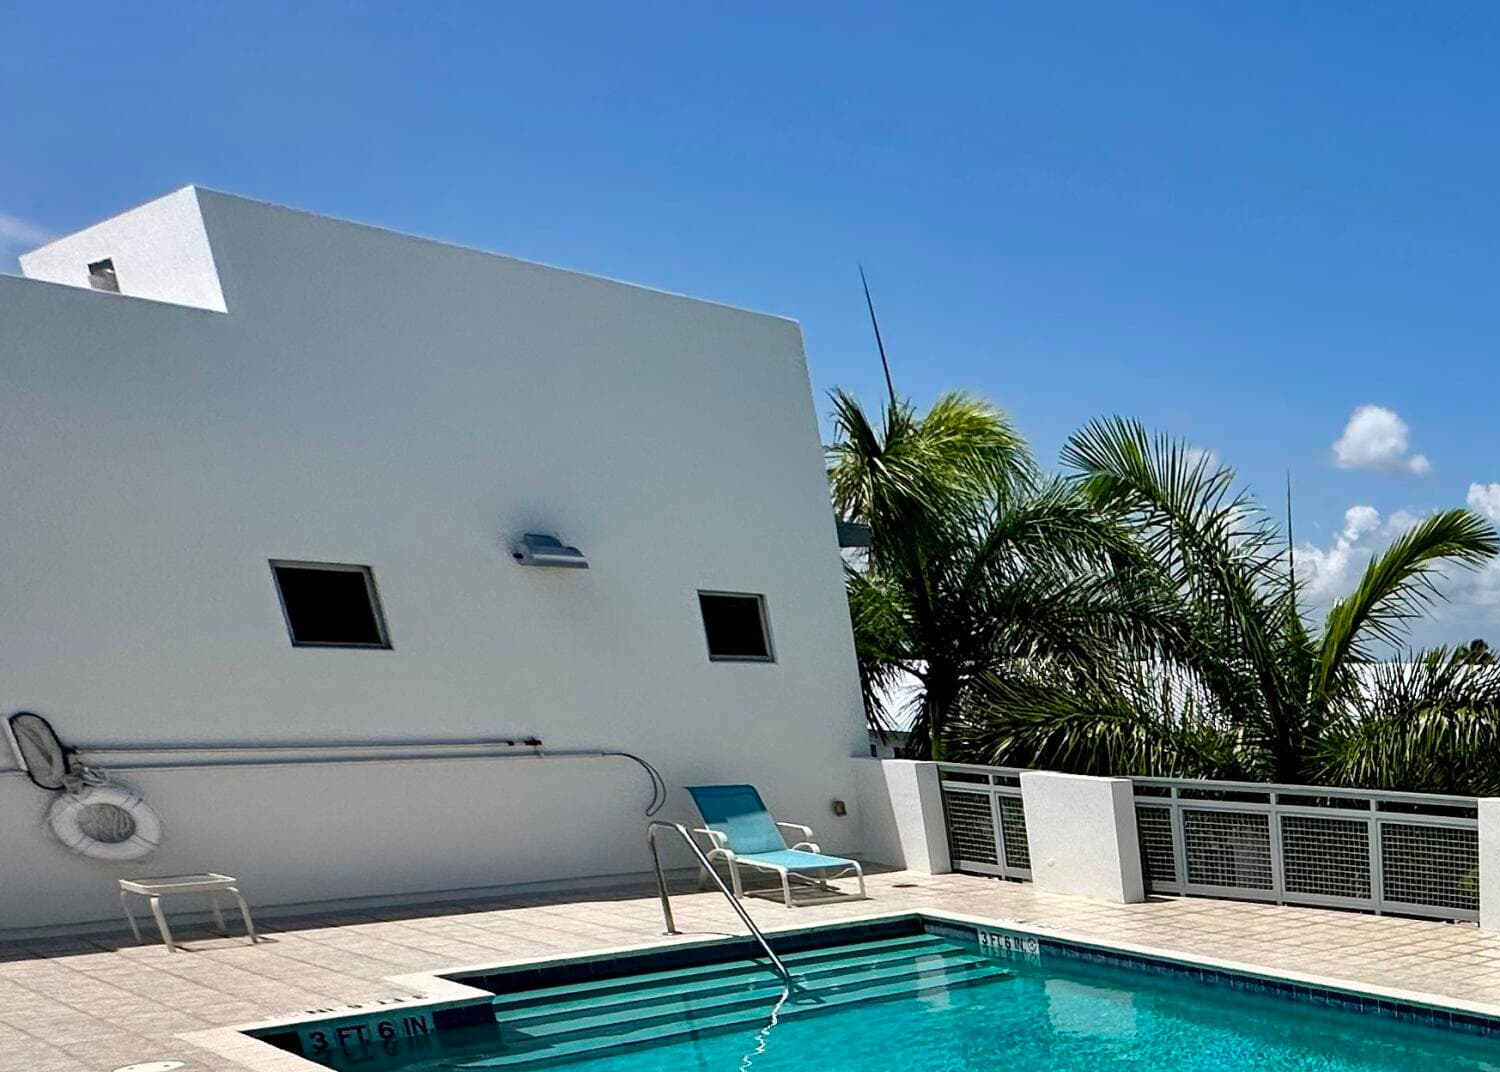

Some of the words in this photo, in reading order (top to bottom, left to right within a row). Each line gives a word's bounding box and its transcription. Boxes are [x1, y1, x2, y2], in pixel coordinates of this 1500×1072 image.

[980, 931, 988, 945] 3
[1004, 936, 1012, 949] 6
[309, 1031, 329, 1049] 3
[378, 1020, 396, 1039] 6
